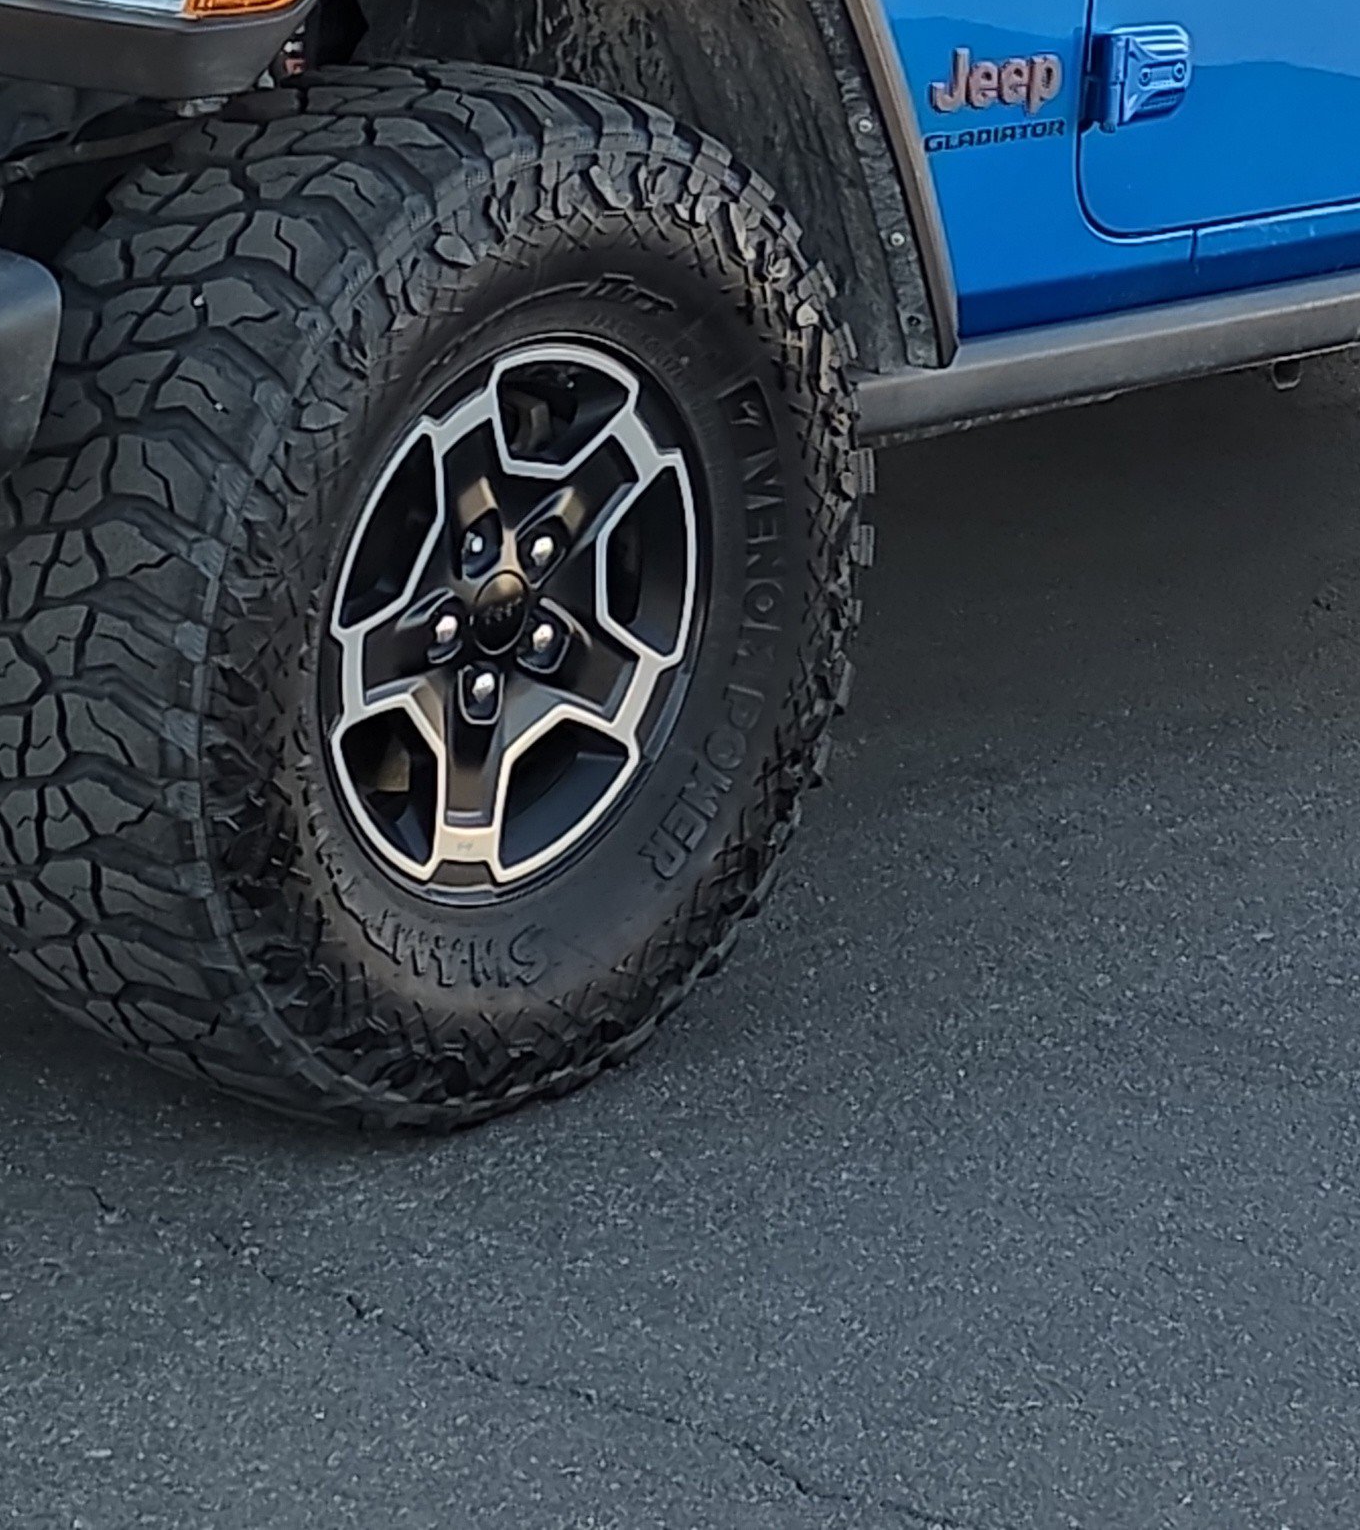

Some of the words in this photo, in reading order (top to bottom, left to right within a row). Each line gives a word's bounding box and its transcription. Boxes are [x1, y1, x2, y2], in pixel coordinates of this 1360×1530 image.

[930, 47, 1062, 115] Jeep
[924, 119, 1066, 153] GLADIATOR
[638, 682, 767, 881] POWER
